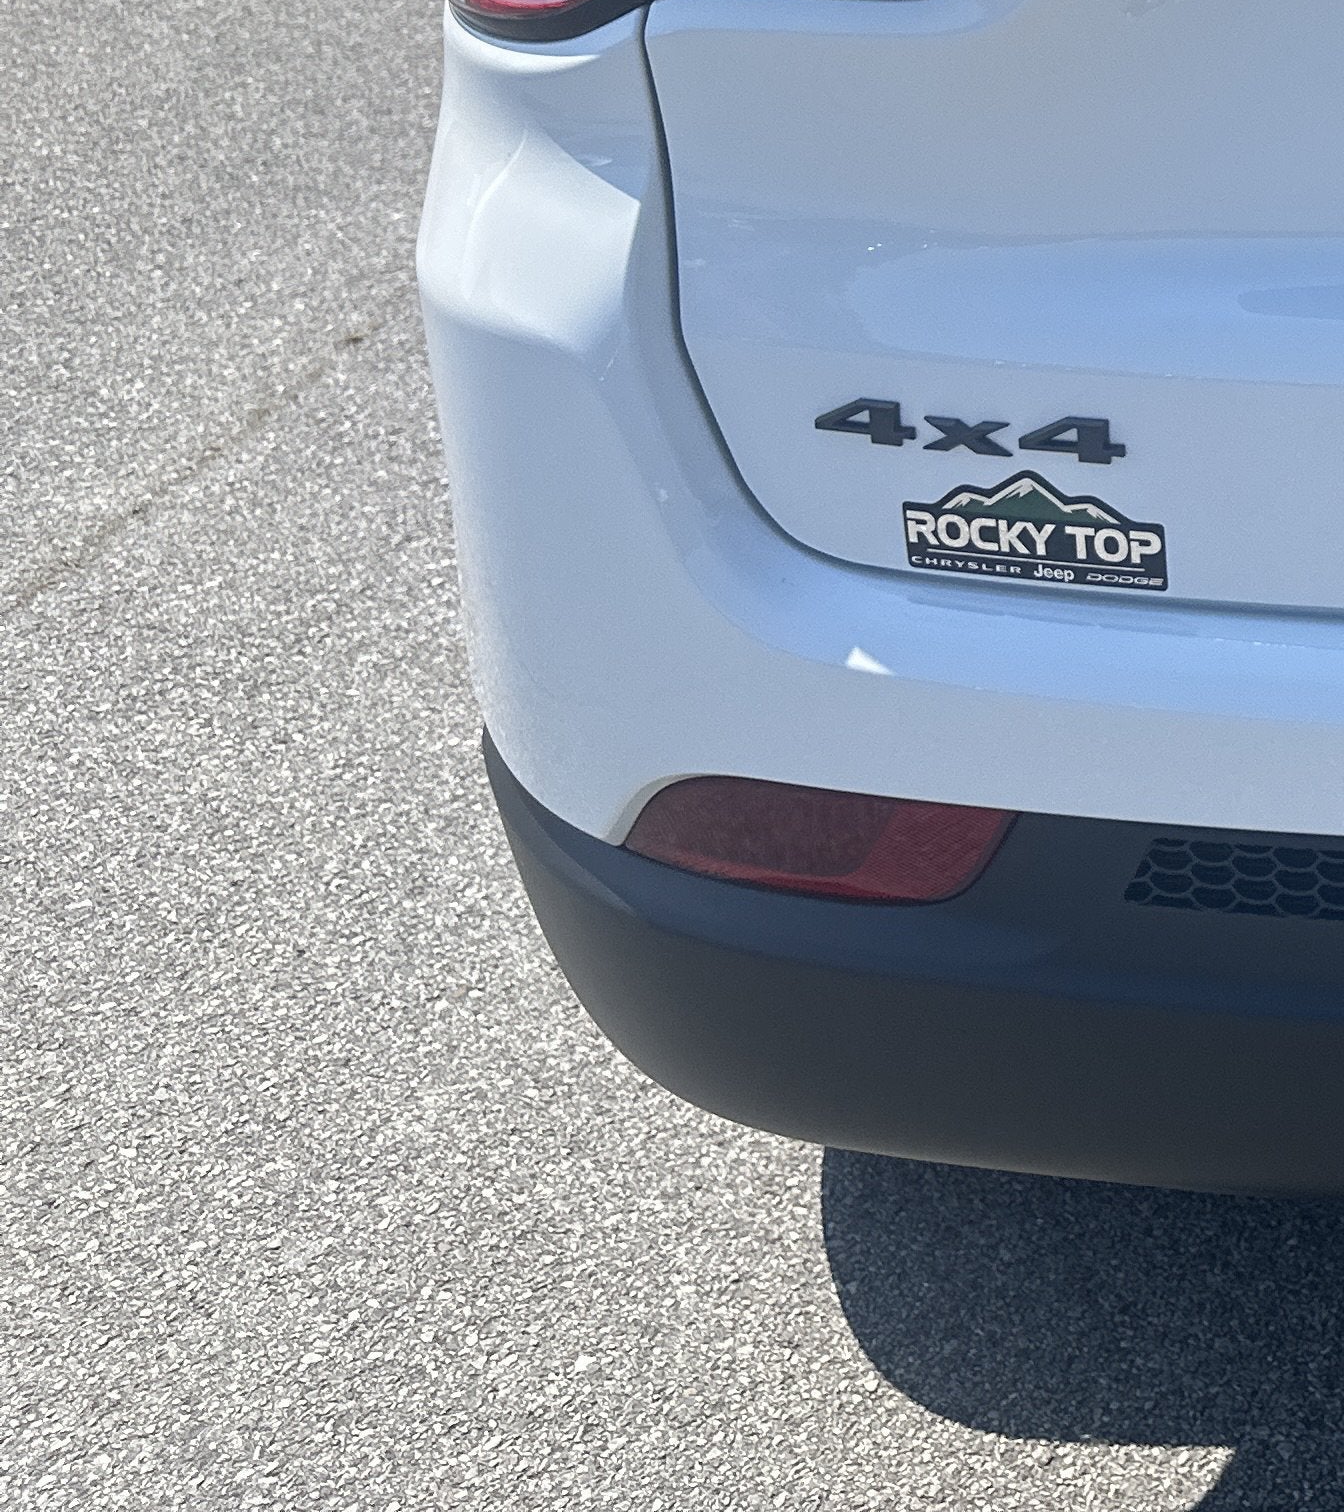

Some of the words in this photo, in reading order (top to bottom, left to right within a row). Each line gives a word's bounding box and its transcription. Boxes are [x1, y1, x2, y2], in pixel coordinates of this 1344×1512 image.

[814, 397, 1127, 465] 4x4
[905, 509, 1056, 556] ROCKY
[1064, 526, 1163, 565] TOP
[911, 555, 1022, 575] CHRYSLER
[1033, 563, 1076, 583] Jeep
[1085, 572, 1165, 586] DODGE
